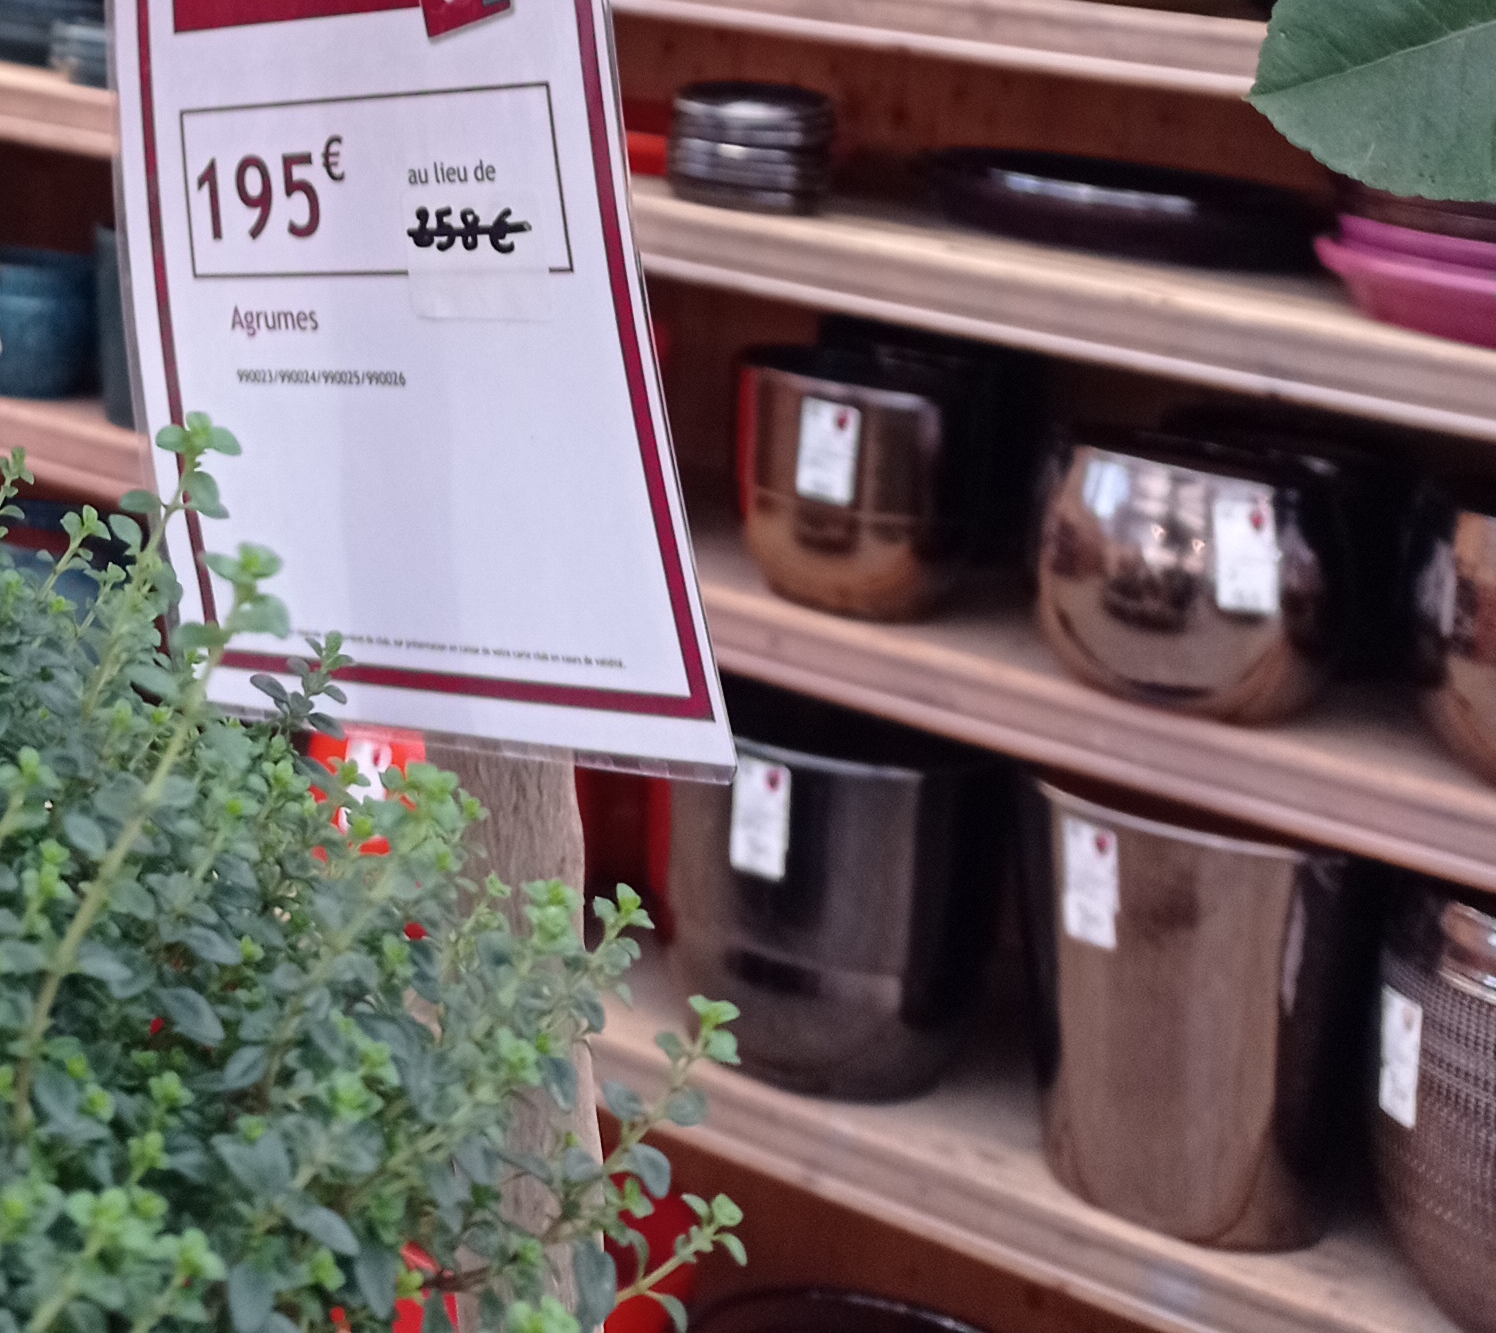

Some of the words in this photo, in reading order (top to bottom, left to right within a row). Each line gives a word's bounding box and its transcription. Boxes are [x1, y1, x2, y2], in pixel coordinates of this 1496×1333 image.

[407, 166, 430, 185] au
[433, 160, 469, 184] lieu
[473, 158, 497, 182] de
[231, 305, 319, 339] Agrumes
